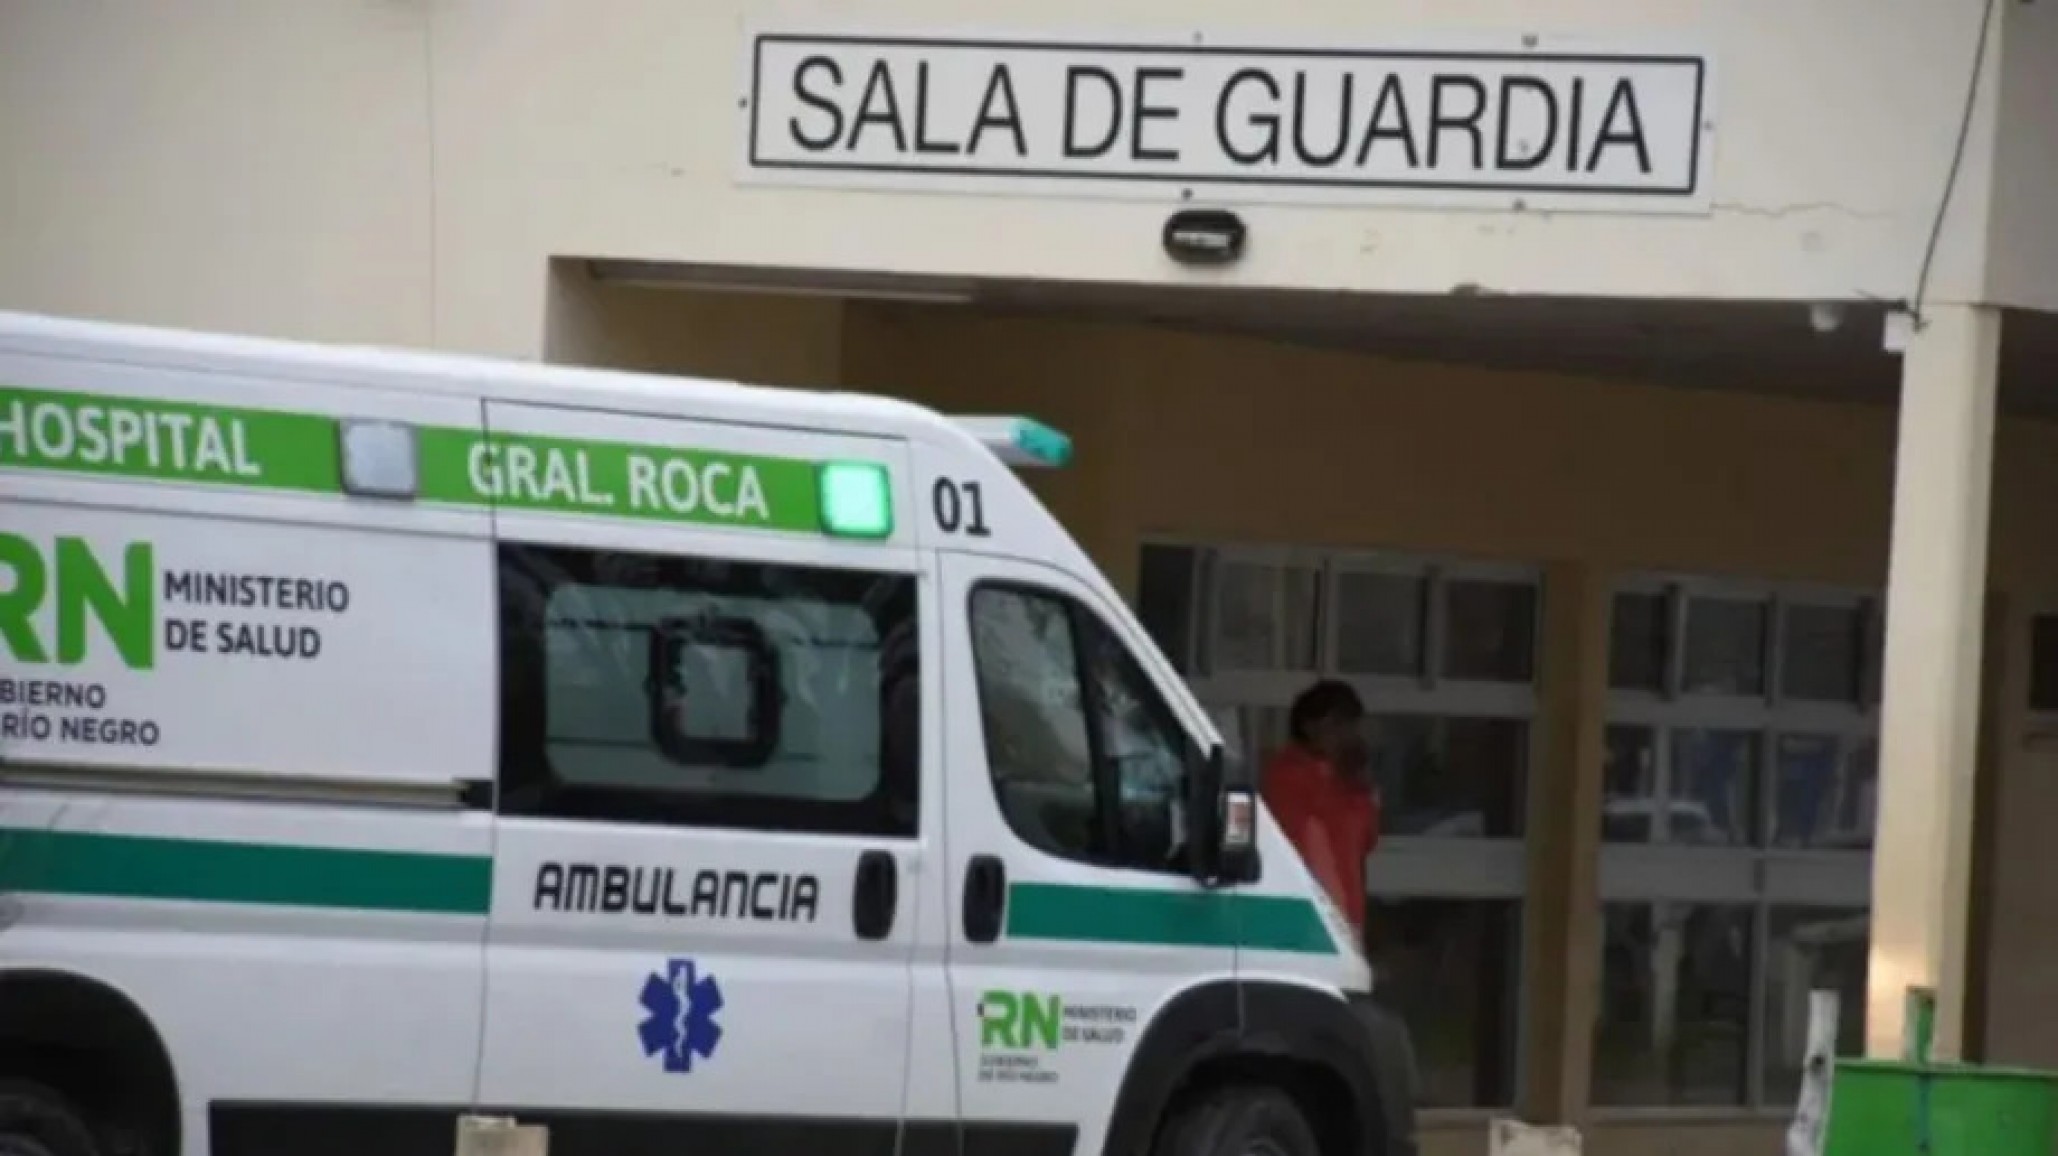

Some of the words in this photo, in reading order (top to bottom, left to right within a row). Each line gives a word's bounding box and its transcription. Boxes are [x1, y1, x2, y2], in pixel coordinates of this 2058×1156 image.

[789, 55, 1028, 156] SALA
[1062, 66, 1184, 162] DE
[1214, 68, 1652, 174] GUARDIA
[0, 400, 261, 476] HOSPITAL
[467, 443, 614, 506] GRAL.
[627, 455, 769, 520] ROCA
[932, 477, 992, 537] 01
[164, 571, 350, 614] MINISTERIO
[165, 619, 208, 653] DE
[217, 621, 322, 659] SALUD
[61, 715, 161, 746] NEGRO
[533, 863, 820, 922] AMBULANCIA
[980, 990, 1061, 1050] RN
